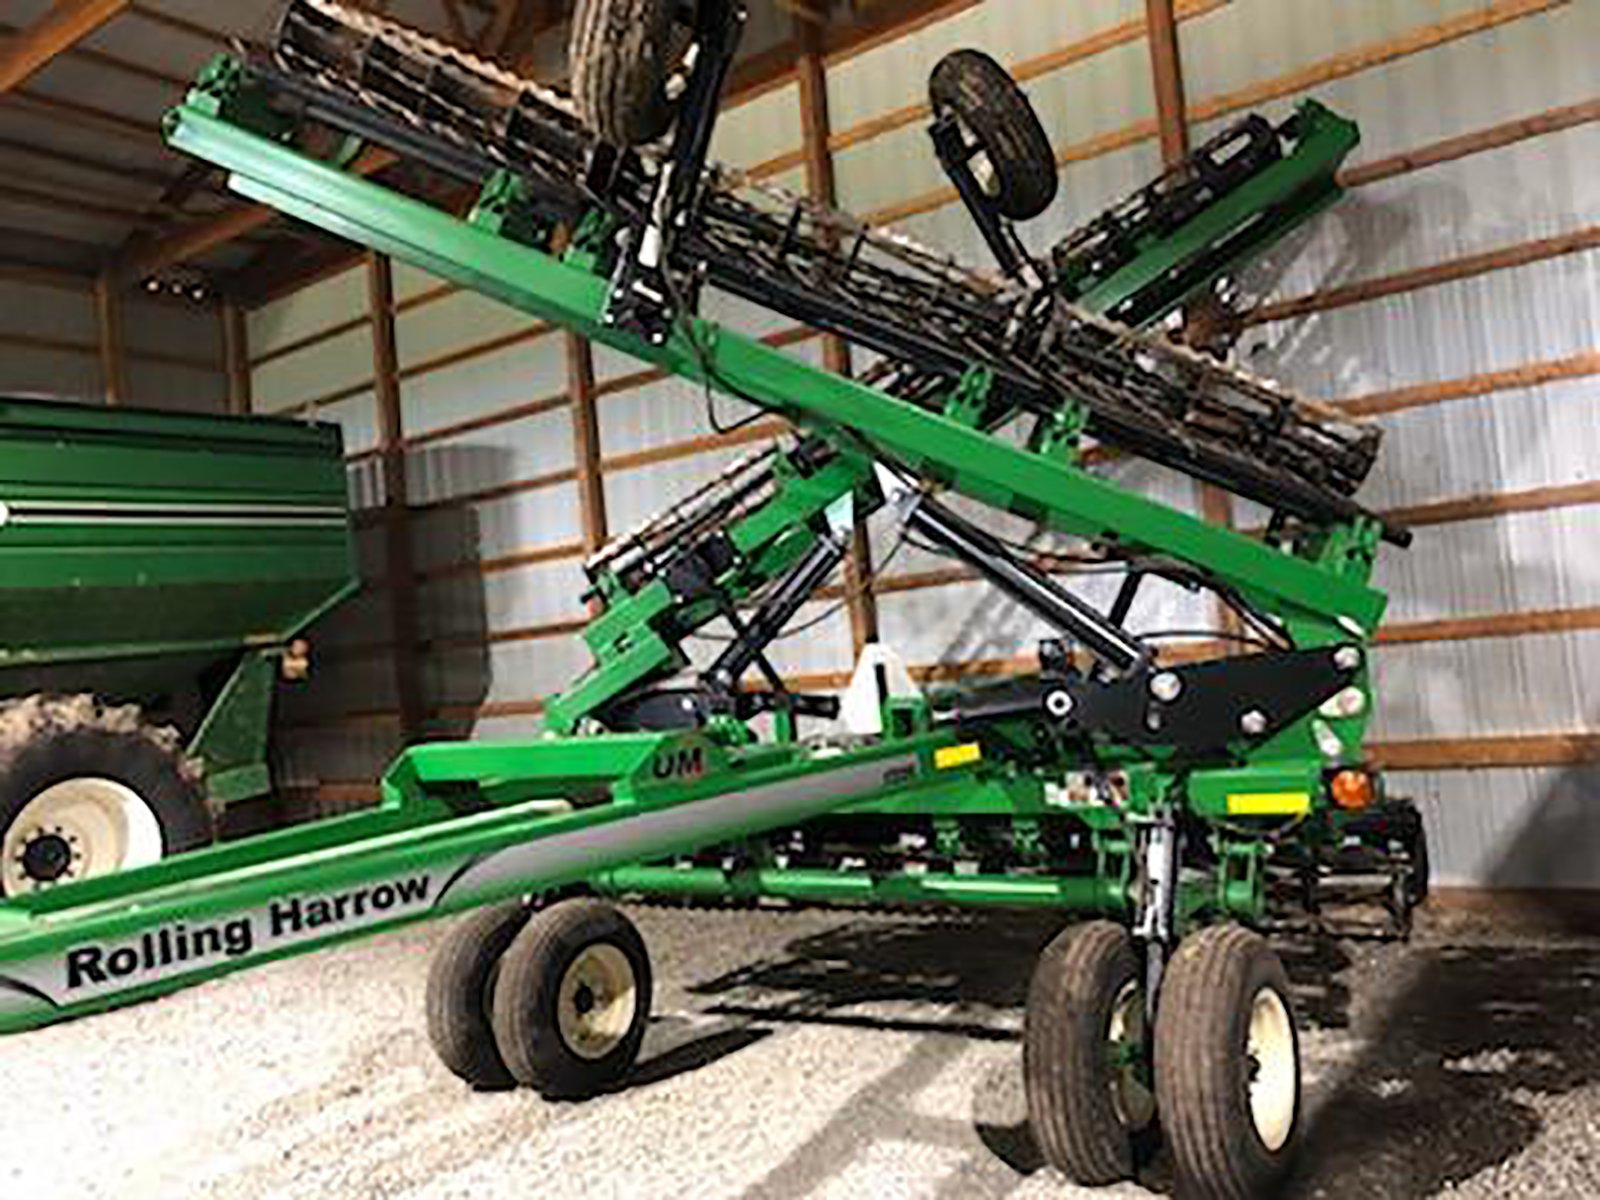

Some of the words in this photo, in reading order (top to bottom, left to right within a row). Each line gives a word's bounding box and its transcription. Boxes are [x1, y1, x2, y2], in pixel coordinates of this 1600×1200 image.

[653, 747, 704, 779] UM
[66, 917, 253, 990] Rolling
[269, 875, 432, 938] Harrow
